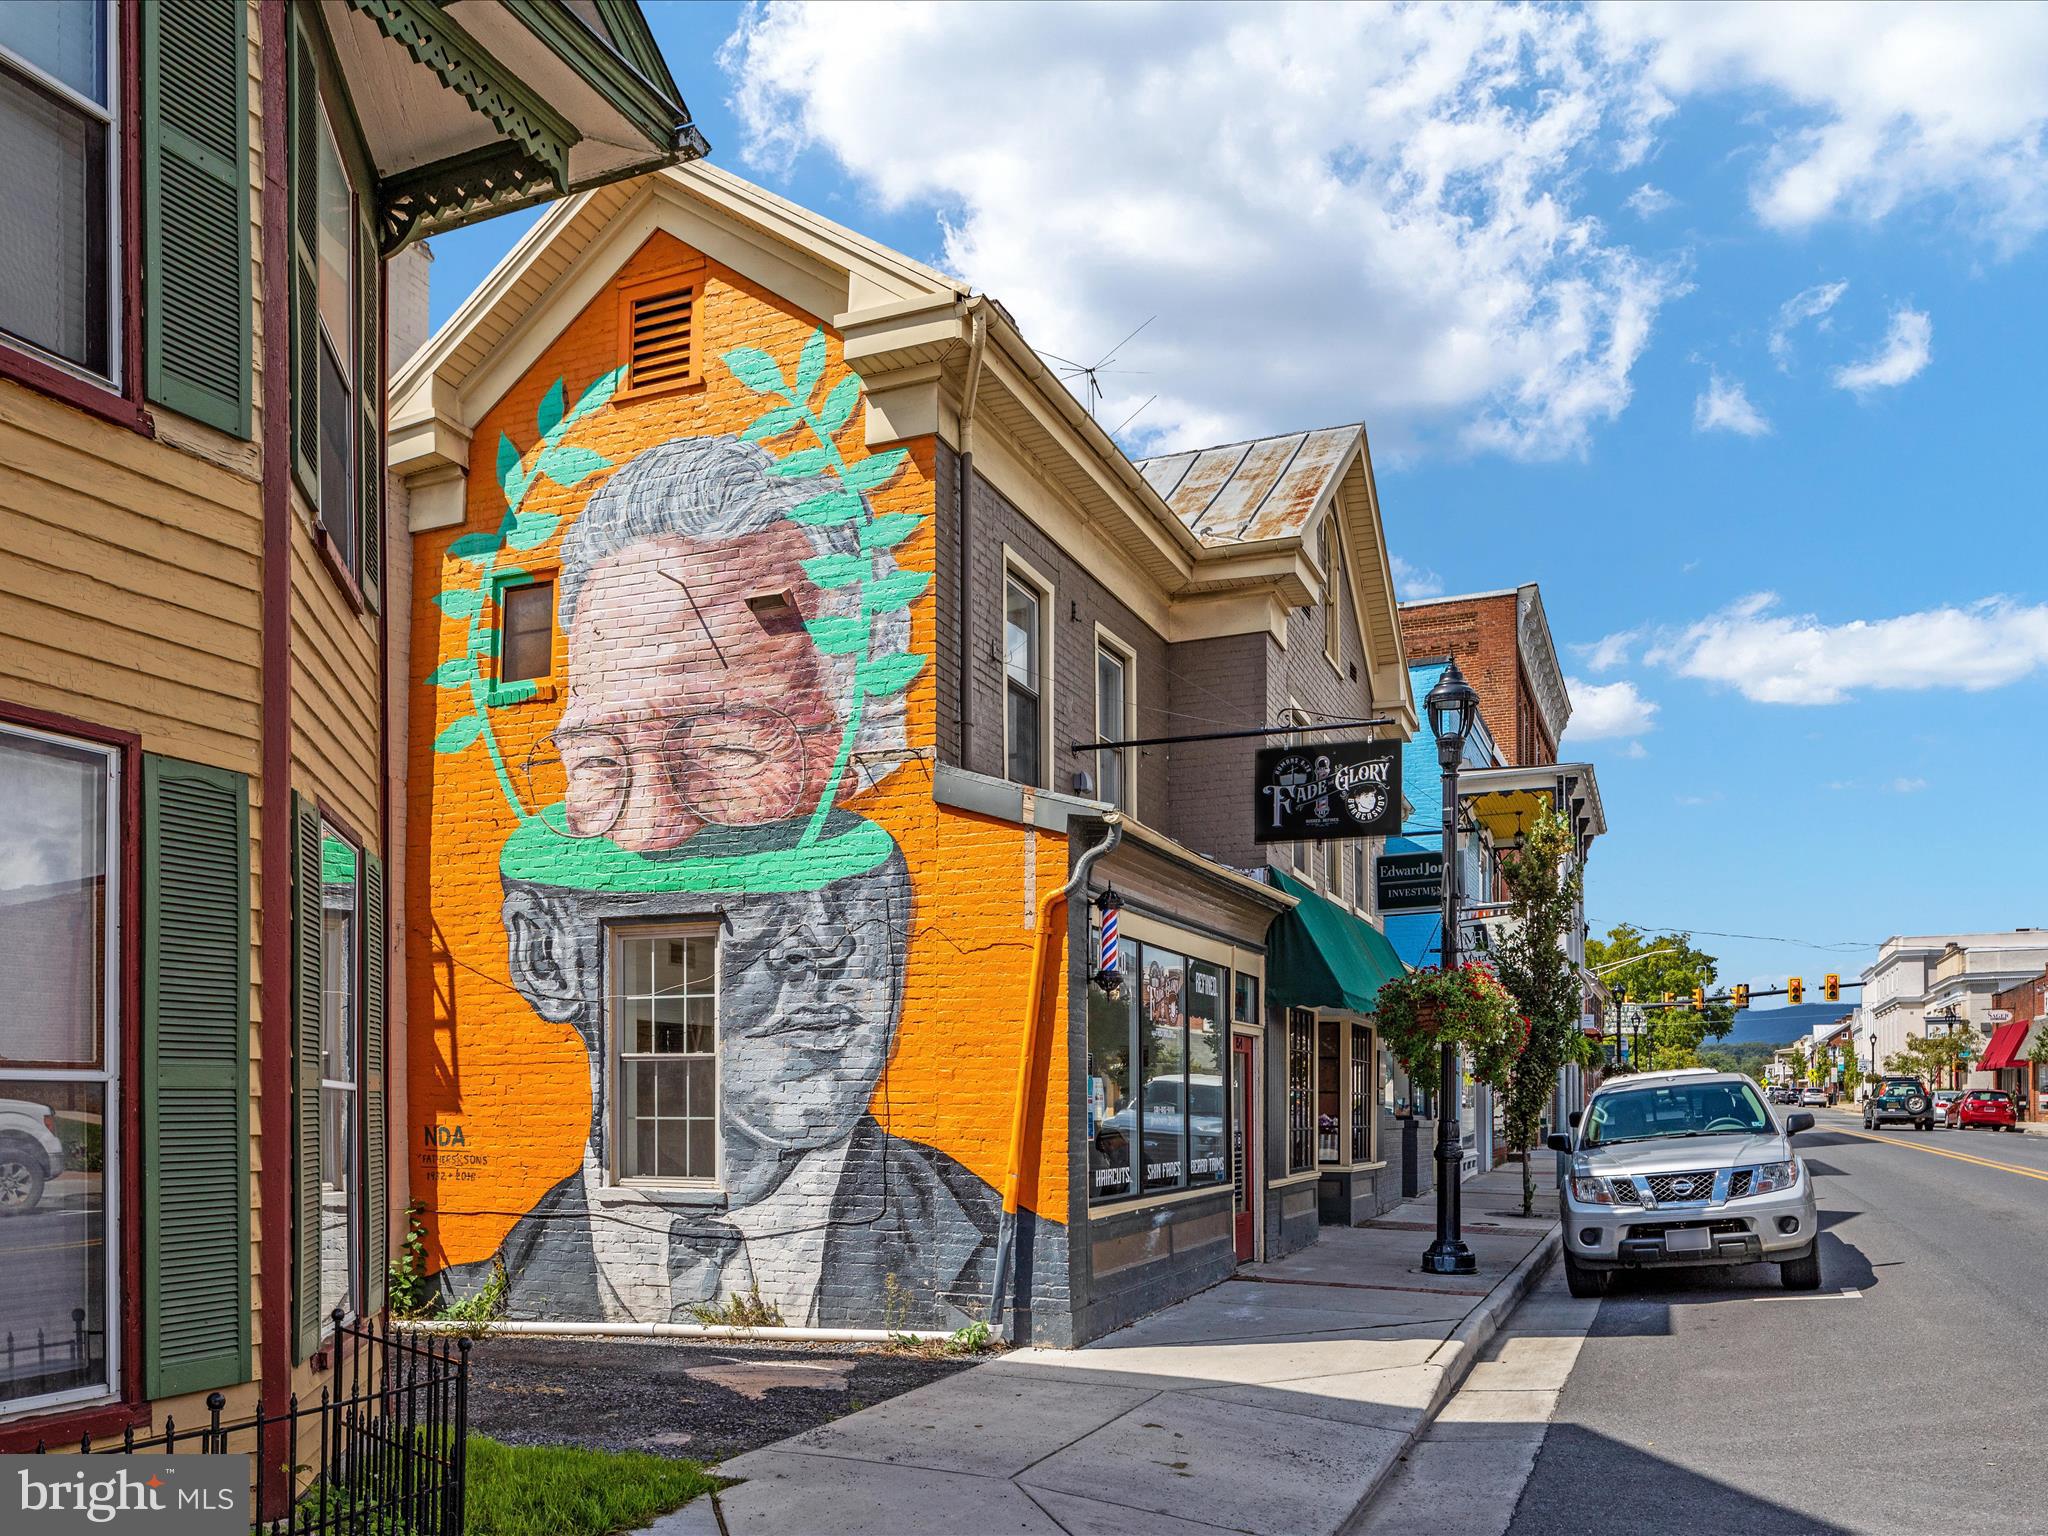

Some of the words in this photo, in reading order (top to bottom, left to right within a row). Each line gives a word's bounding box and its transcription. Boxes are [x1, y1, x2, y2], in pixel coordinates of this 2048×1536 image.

[1263, 780, 1328, 827] FADE
[1335, 763, 1390, 791] GLORY
[1347, 795, 1385, 821] BARBERSHOP
[1388, 886, 1442, 898] INVESTMEN
[424, 1125, 465, 1147] NDA
[463, 1155, 488, 1165] SONS
[1190, 1158, 1208, 1174] BEARD
[1162, 1161, 1181, 1178] FADES
